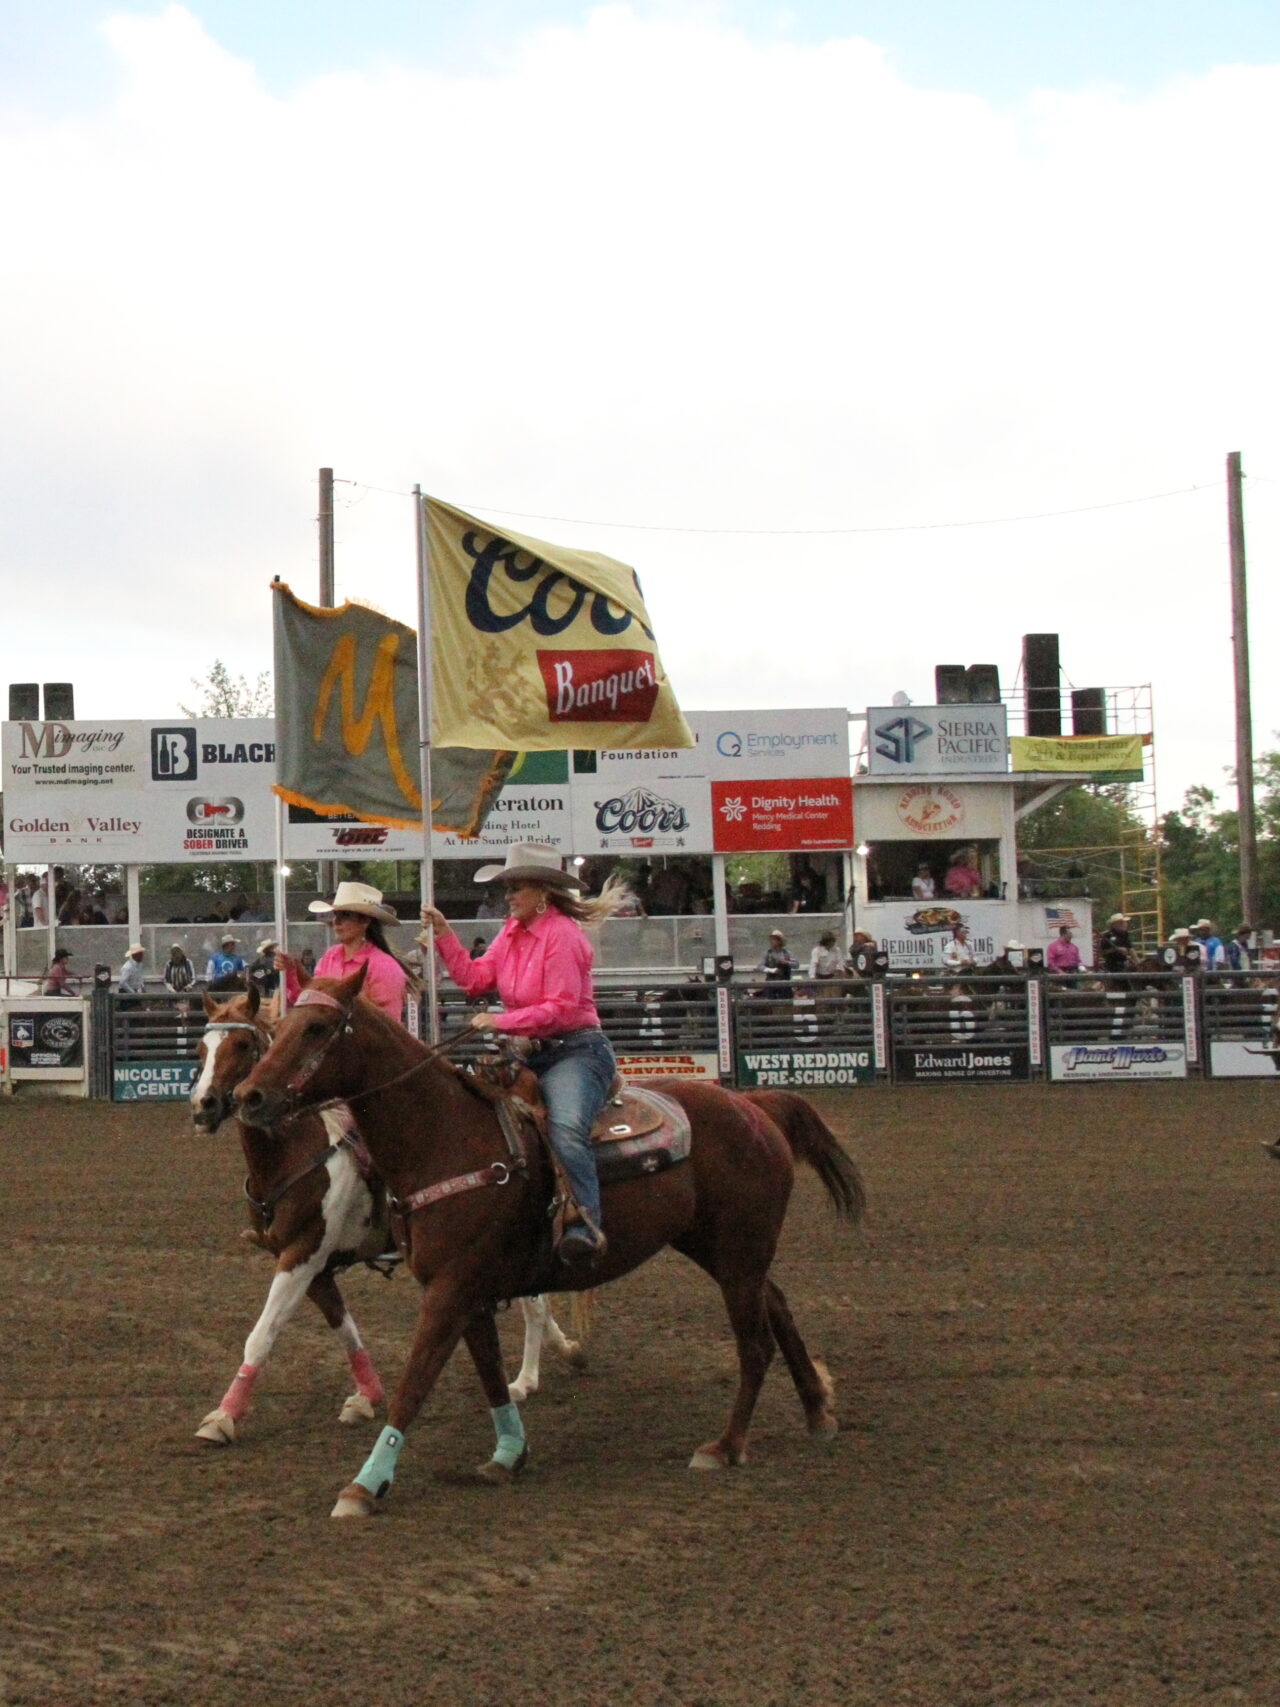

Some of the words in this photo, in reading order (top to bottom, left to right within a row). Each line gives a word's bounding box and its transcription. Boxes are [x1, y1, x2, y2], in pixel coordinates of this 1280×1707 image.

[553, 659, 656, 715] Banquet
[937, 720, 997, 737] SIERRA
[18, 722, 73, 759] MD
[54, 729, 125, 753] imaging
[747, 732, 839, 749] Employment
[937, 737, 1000, 754] PACIFIC
[600, 750, 678, 761] Foundation
[11, 764, 31, 774] Your
[32, 763, 67, 774] Trusted
[68, 763, 103, 775] imaging
[104, 763, 135, 773] center.
[491, 796, 564, 812] eraton
[751, 796, 796, 810] Dignity
[798, 794, 839, 806] Health
[594, 797, 689, 834] Coors
[775, 812, 803, 820] Medical
[804, 811, 828, 819] Center
[9, 818, 70, 833] Golden
[86, 817, 142, 834] Valley
[186, 828, 235, 838] DESIGNATE
[238, 828, 245, 838] A
[511, 820, 541, 830] Hotel
[183, 839, 213, 849] SOBER
[215, 838, 249, 849] DRIVER
[444, 837, 456, 846] At
[880, 937, 933, 956] REDDING
[793, 999, 819, 1043] 5
[744, 1054, 791, 1069] WEST
[792, 1053, 869, 1068] REDDING
[914, 1053, 967, 1068] Edward
[967, 1052, 1012, 1069] Jones
[113, 1068, 182, 1081] NICOLET
[617, 1066, 705, 1074] CAVATING
[756, 1070, 858, 1085] PRE-SCHOOL
[137, 1082, 191, 1095] CENTE
